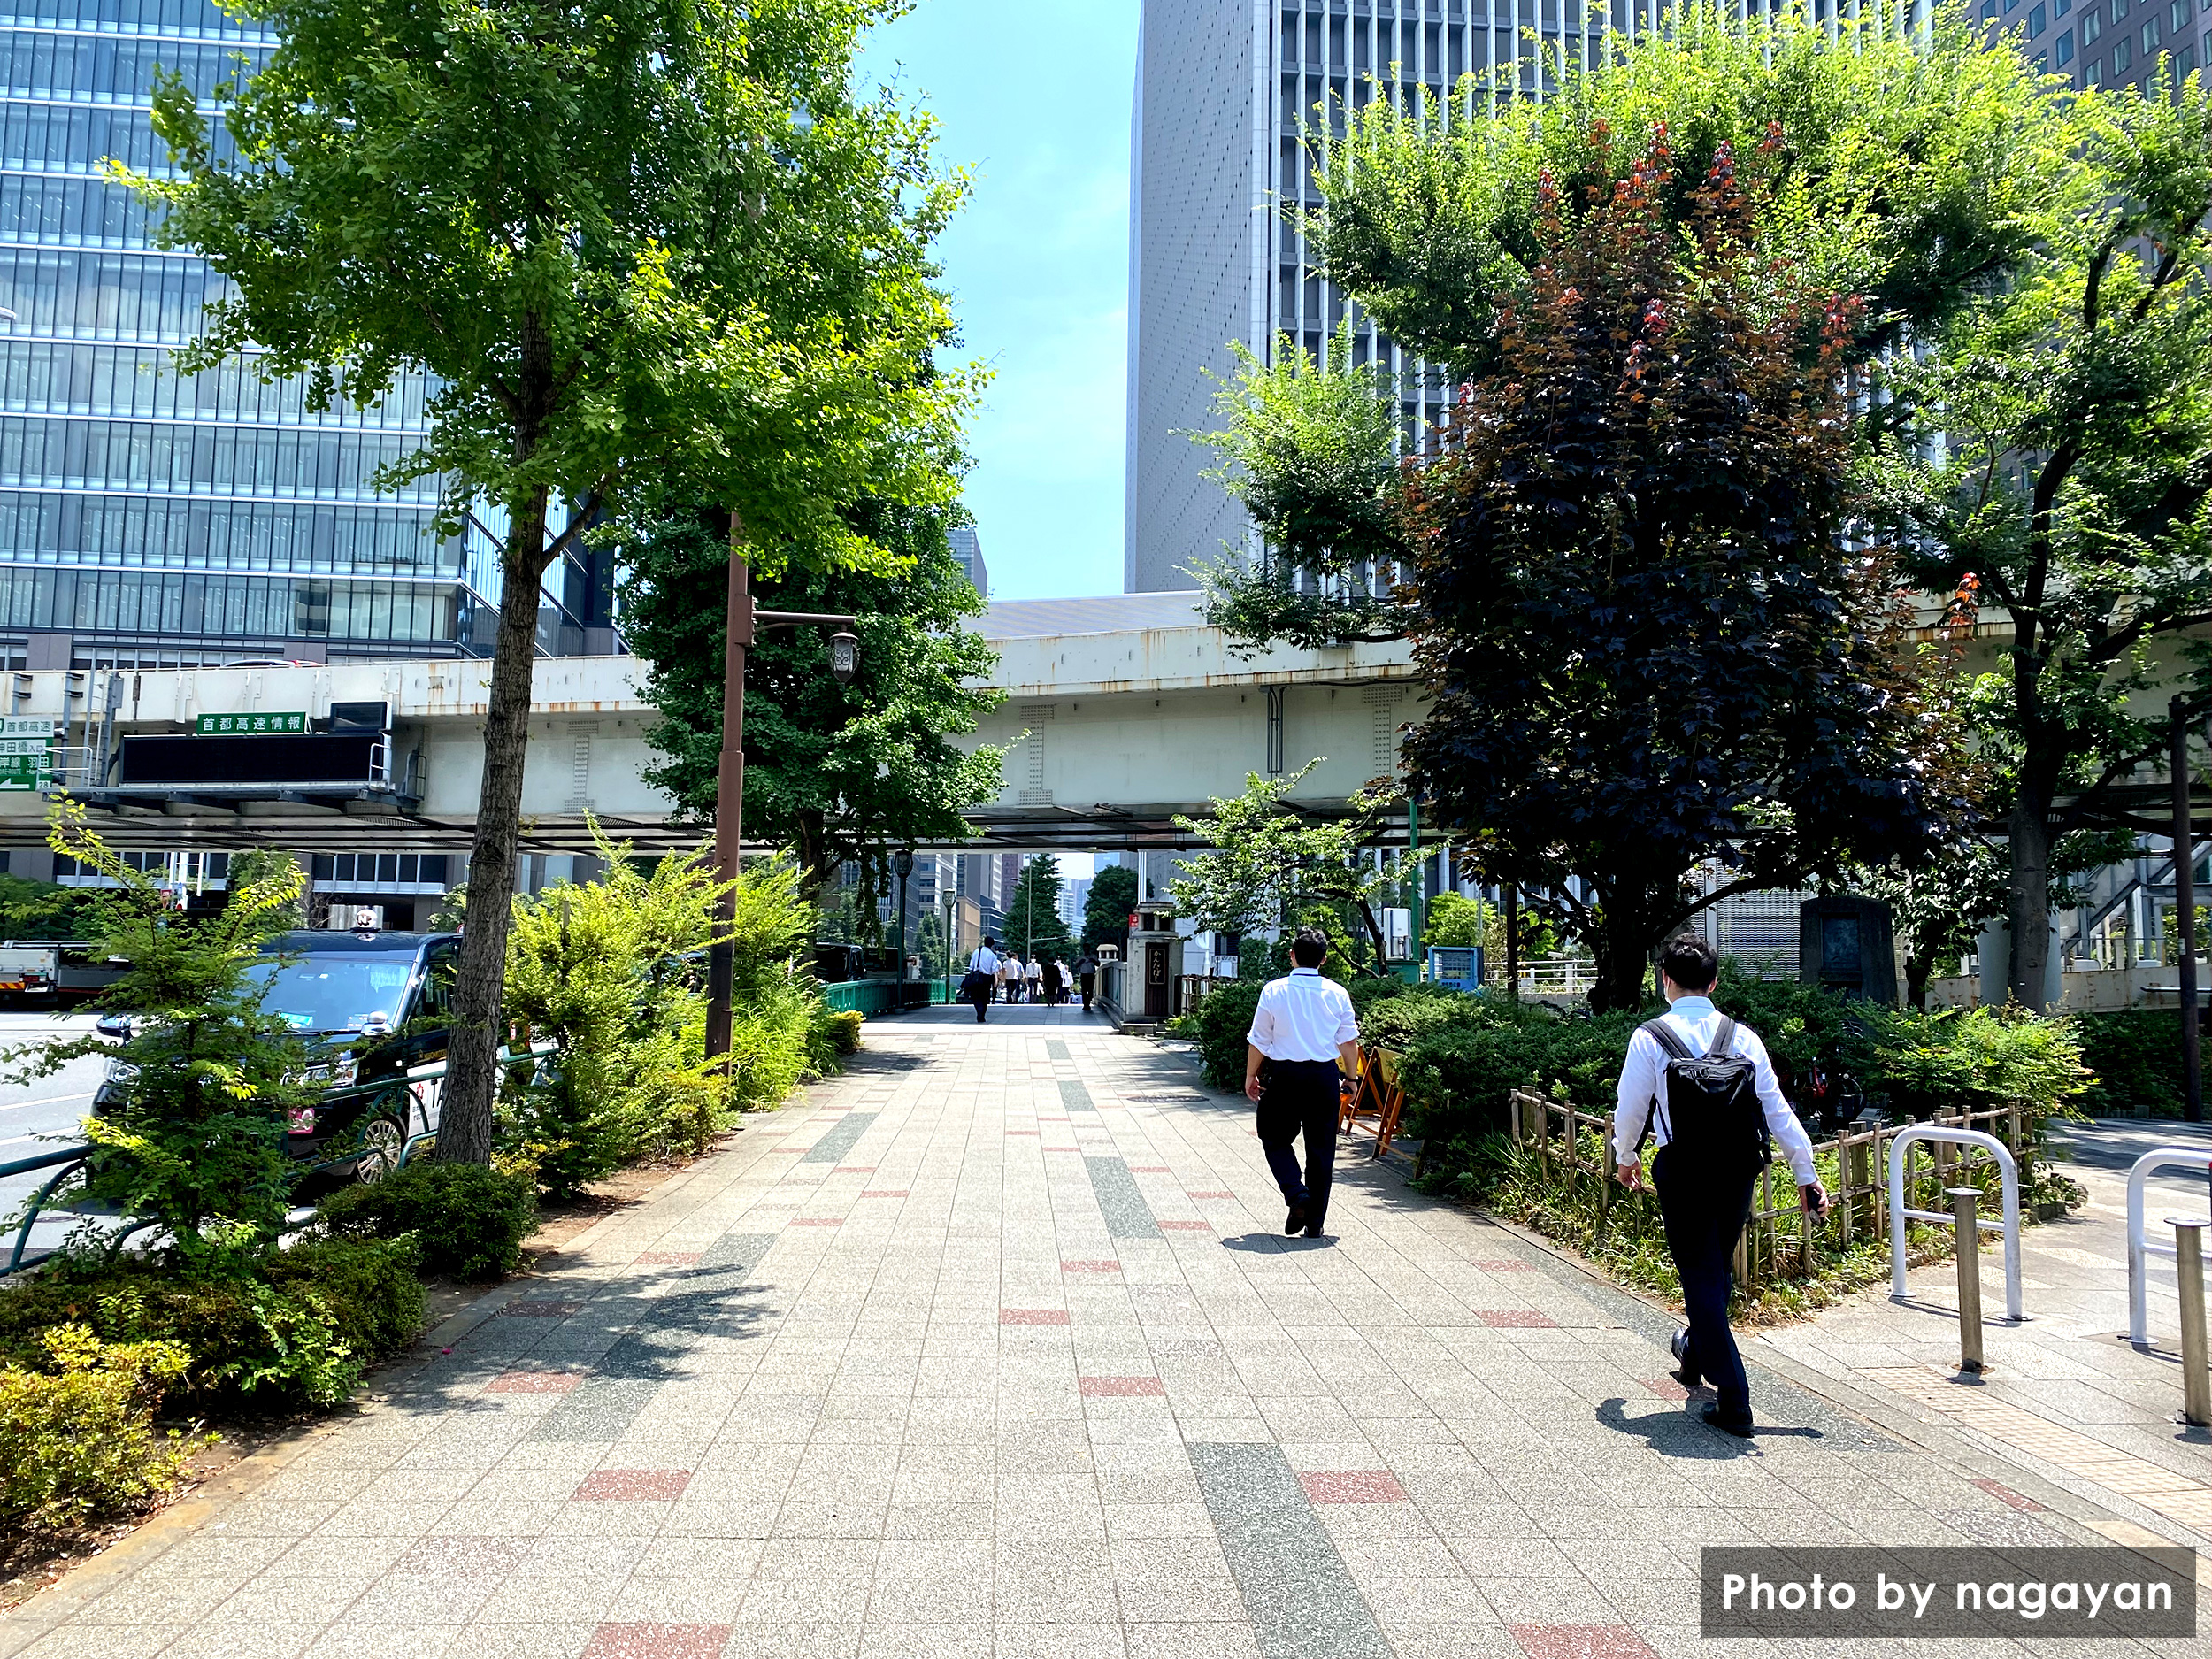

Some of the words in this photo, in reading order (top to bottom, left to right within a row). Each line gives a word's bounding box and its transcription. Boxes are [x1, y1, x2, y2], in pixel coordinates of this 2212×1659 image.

[7, 720, 50, 733] 首都高速
[203, 716, 301, 731] 首都高速情報
[1152, 950, 1162, 983] かんだばし
